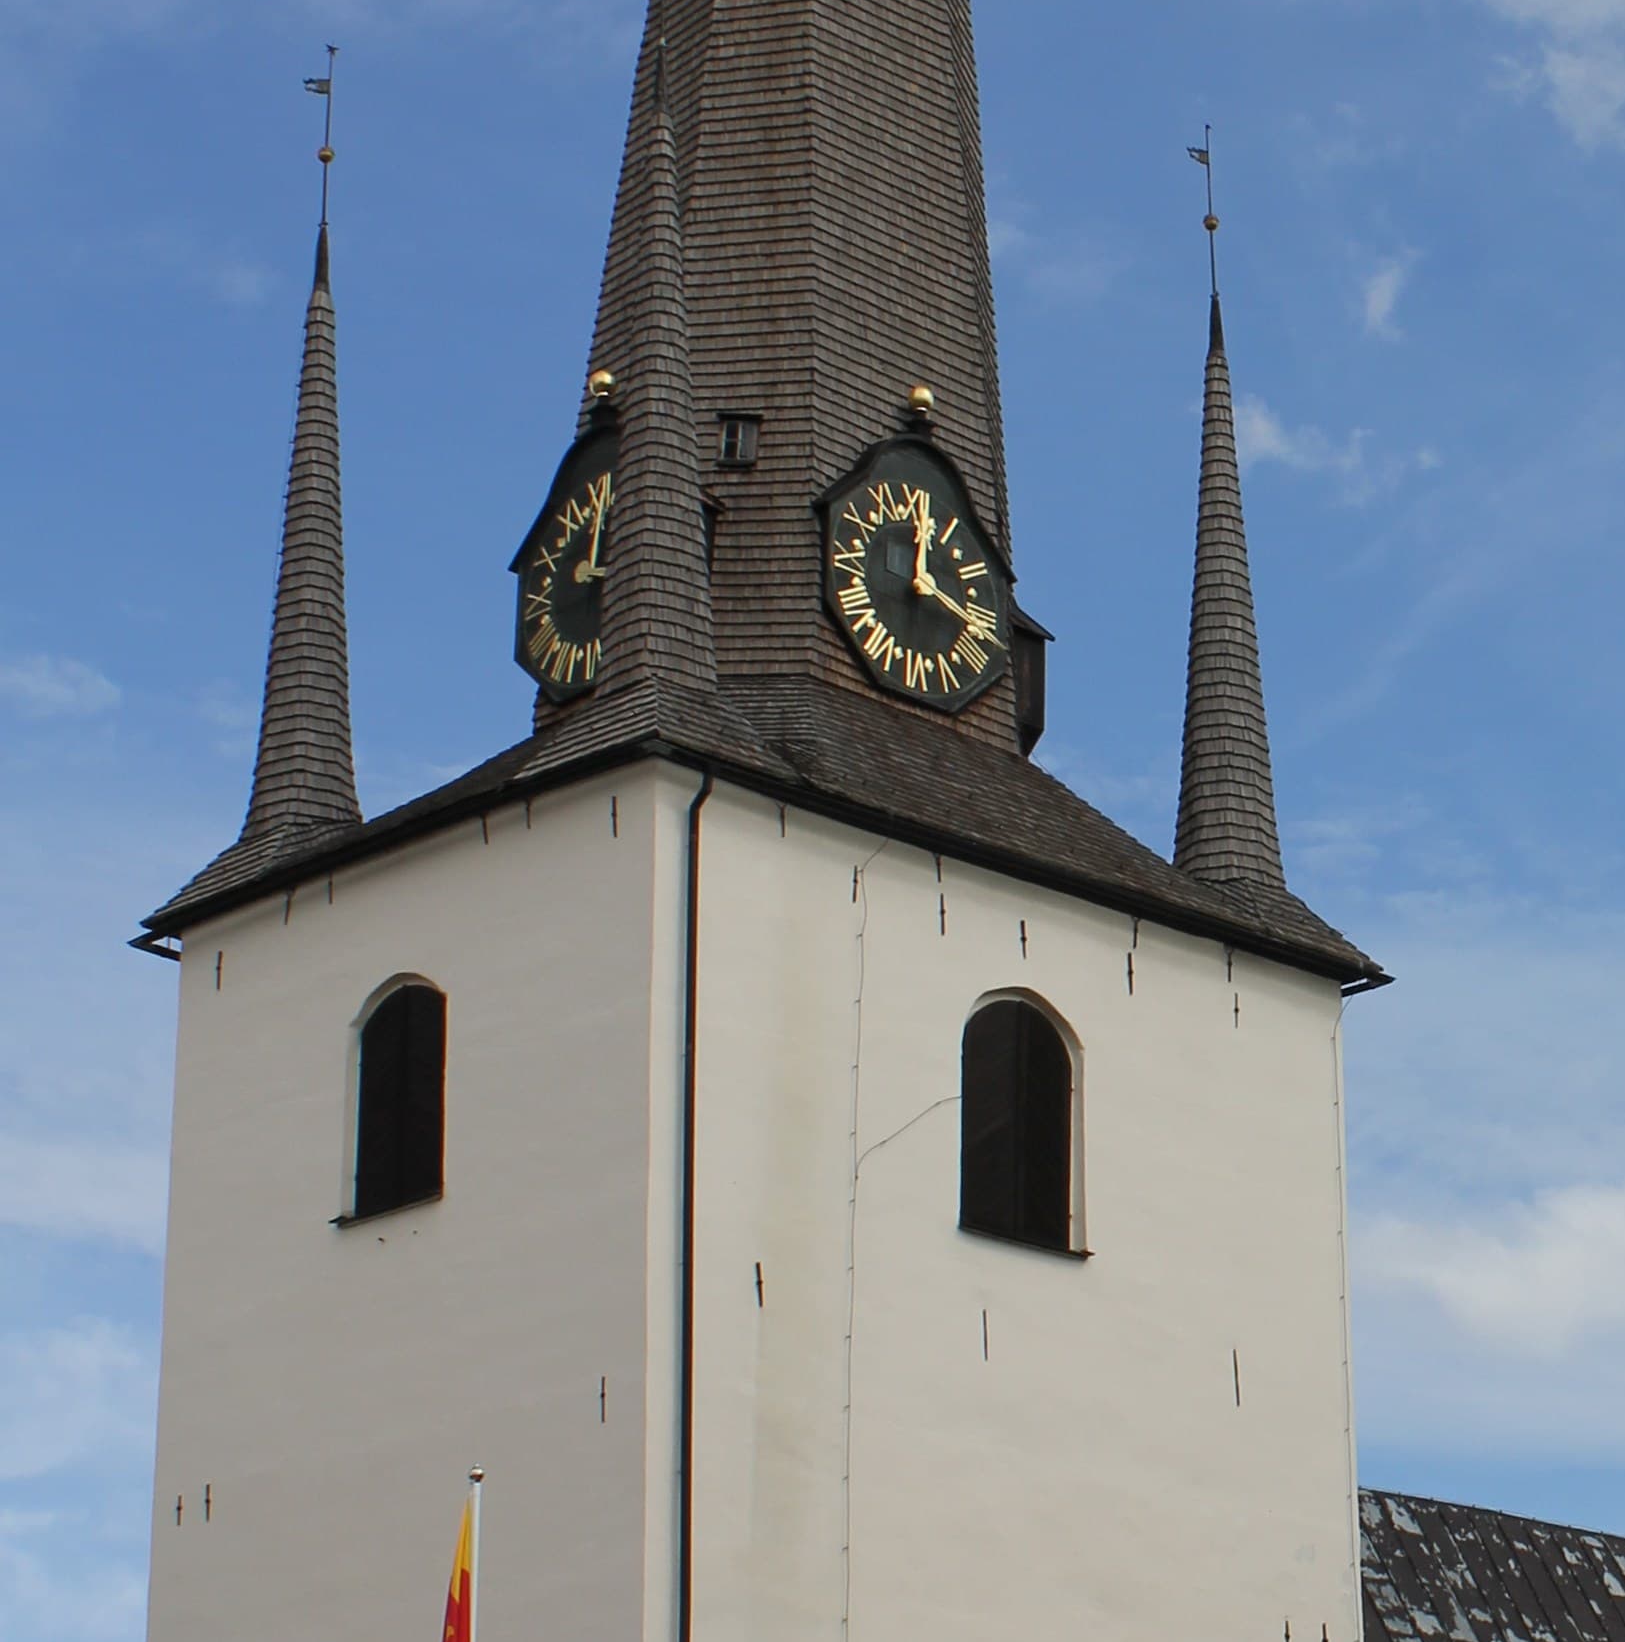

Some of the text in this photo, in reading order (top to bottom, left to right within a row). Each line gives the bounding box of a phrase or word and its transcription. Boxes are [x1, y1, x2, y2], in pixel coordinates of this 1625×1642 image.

[556, 498, 585, 543] XI
[842, 500, 877, 544] X
[867, 482, 902, 526] XI
[940, 516, 960, 547] I
[532, 545, 562, 573] X
[834, 539, 867, 579] IX
[957, 560, 989, 582] II
[525, 585, 553, 622] IX
[837, 583, 876, 634] VIII
[863, 621, 896, 674] VII
[954, 629, 990, 676] IIII
[903, 647, 930, 693] VI
[935, 651, 962, 695] V
